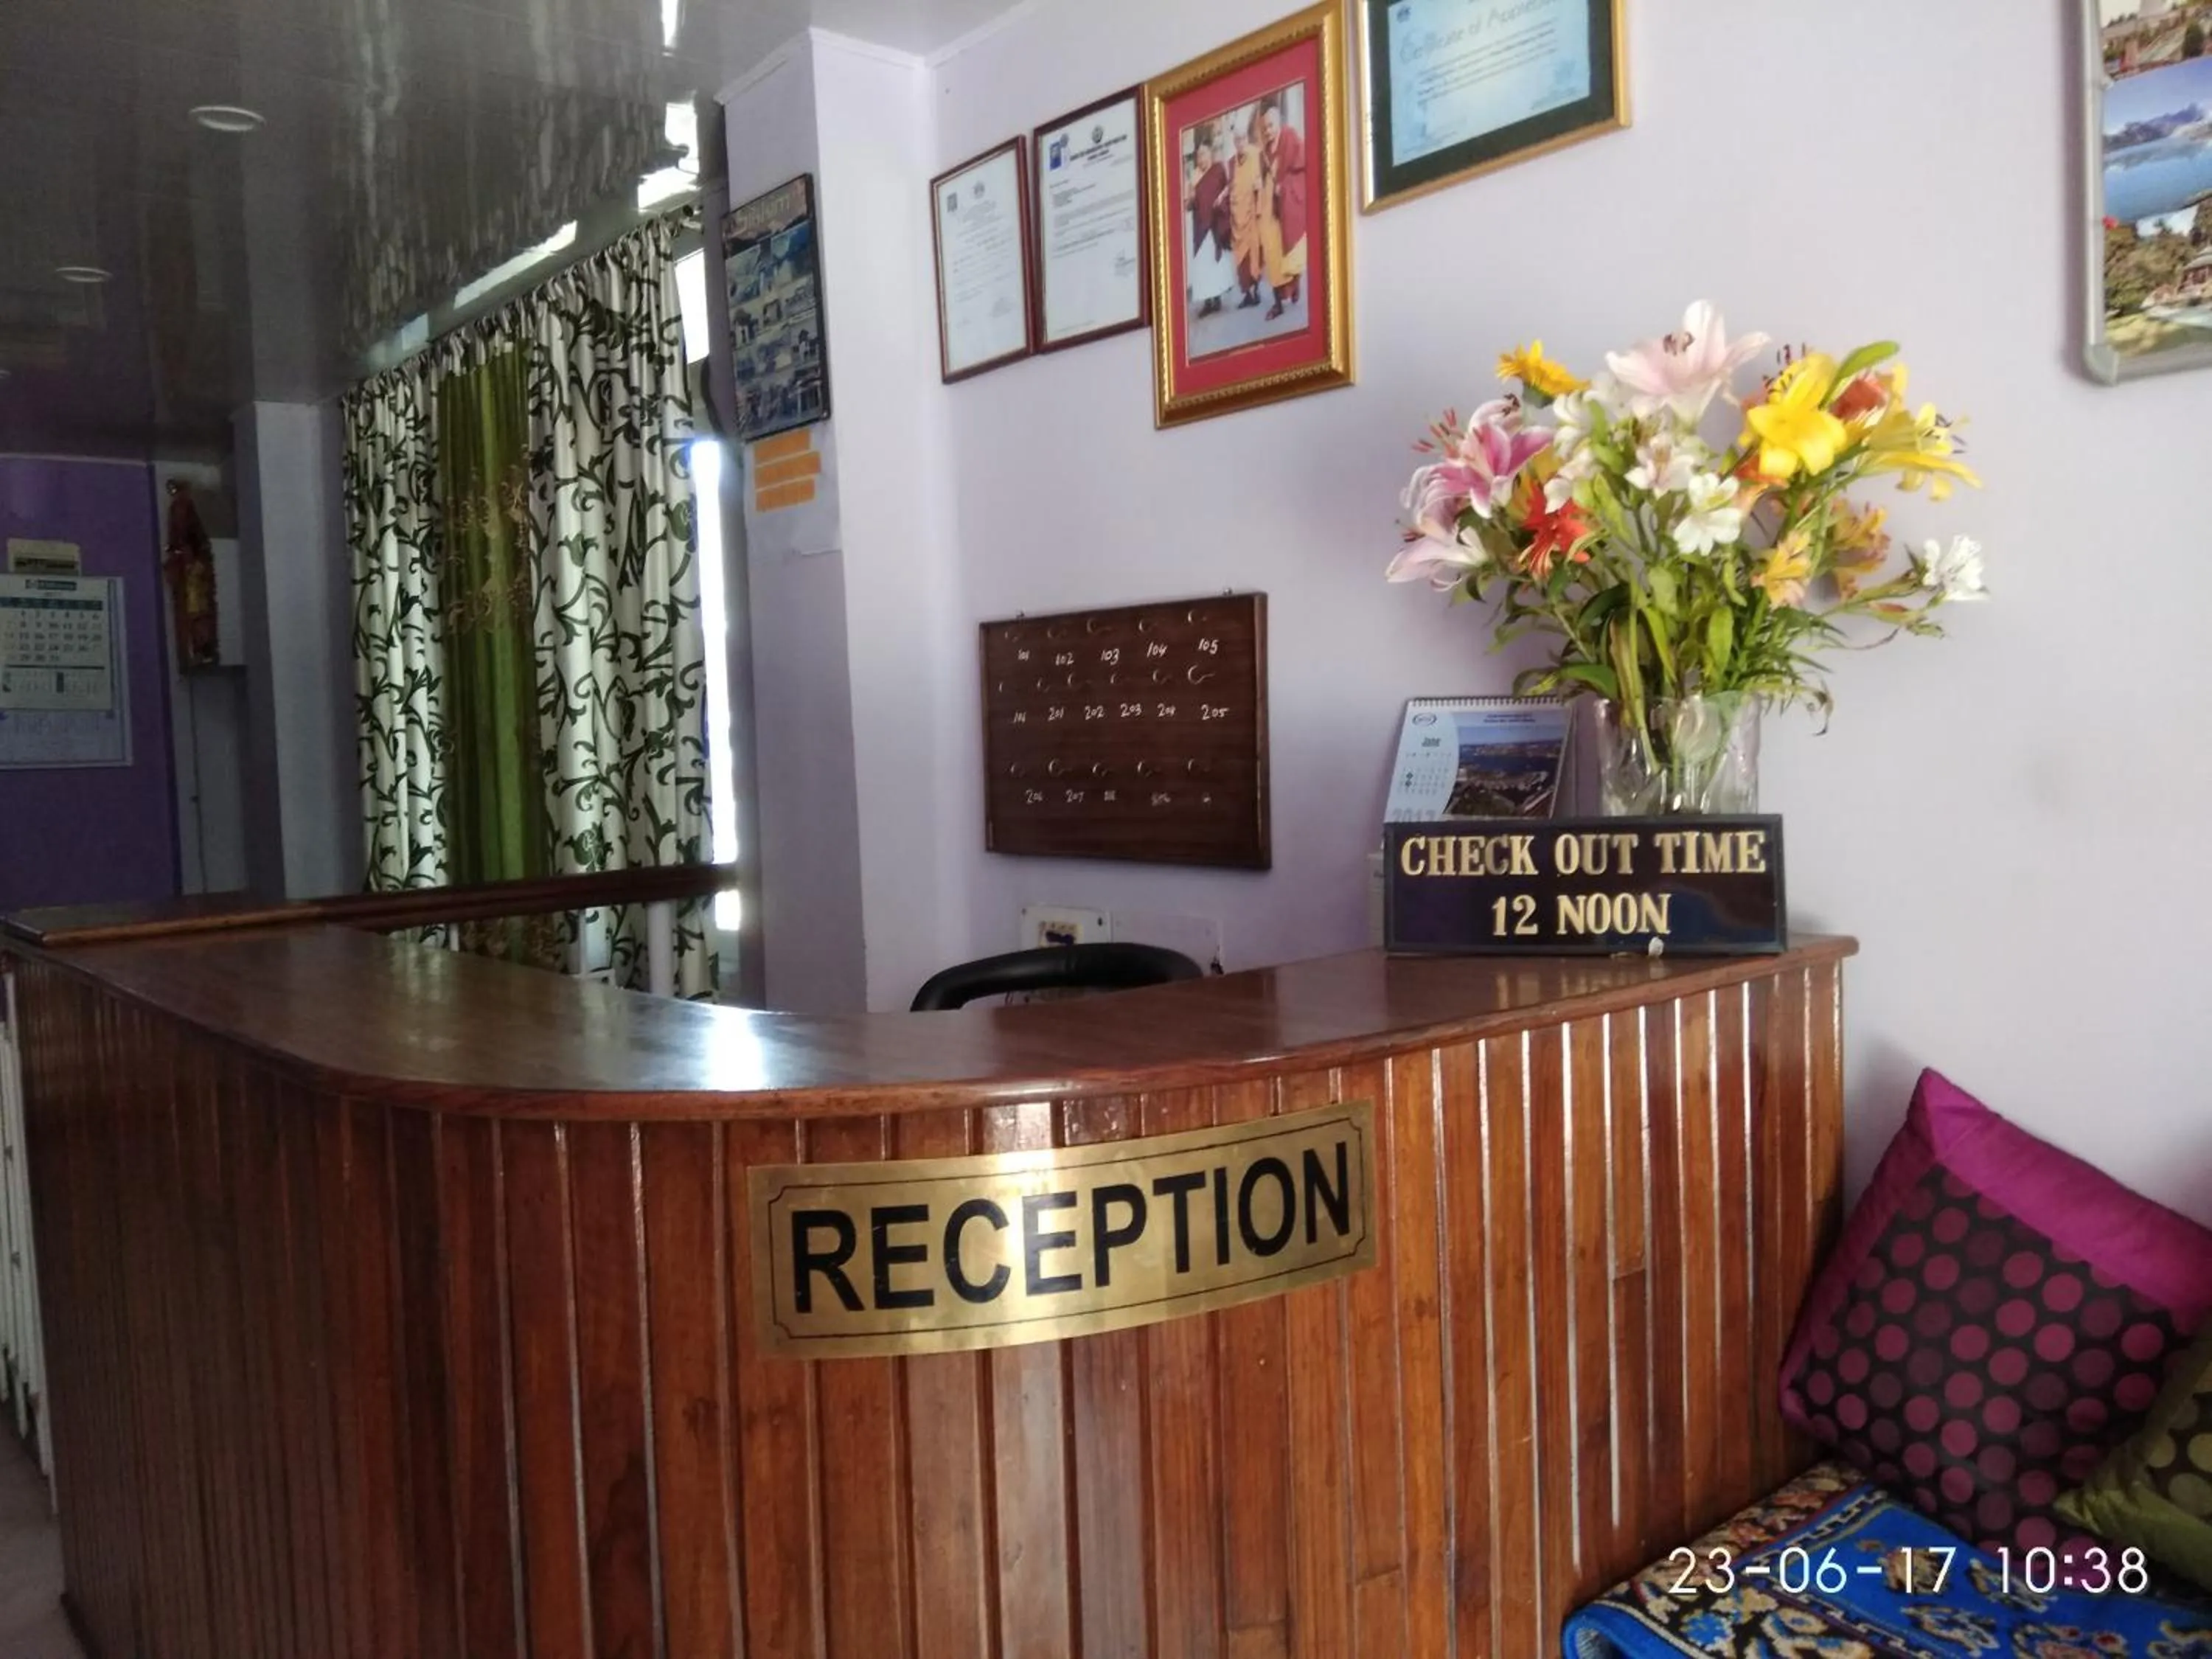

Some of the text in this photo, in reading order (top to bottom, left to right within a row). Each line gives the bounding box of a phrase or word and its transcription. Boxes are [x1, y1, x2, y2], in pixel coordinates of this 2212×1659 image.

[1055, 651, 1074, 666] 102
[1100, 648, 1119, 665] 103
[1147, 641, 1168, 658] 104
[1197, 638, 1219, 655] 105
[1048, 706, 1065, 721] 201
[1084, 705, 1106, 720] 202
[1119, 702, 1142, 717] 203
[1200, 703, 1230, 721] 205
[1401, 830, 1766, 877] CHECK OUT TIME
[1491, 892, 1672, 937] 12 NOON
[790, 1141, 1351, 1314] RECEPTION
